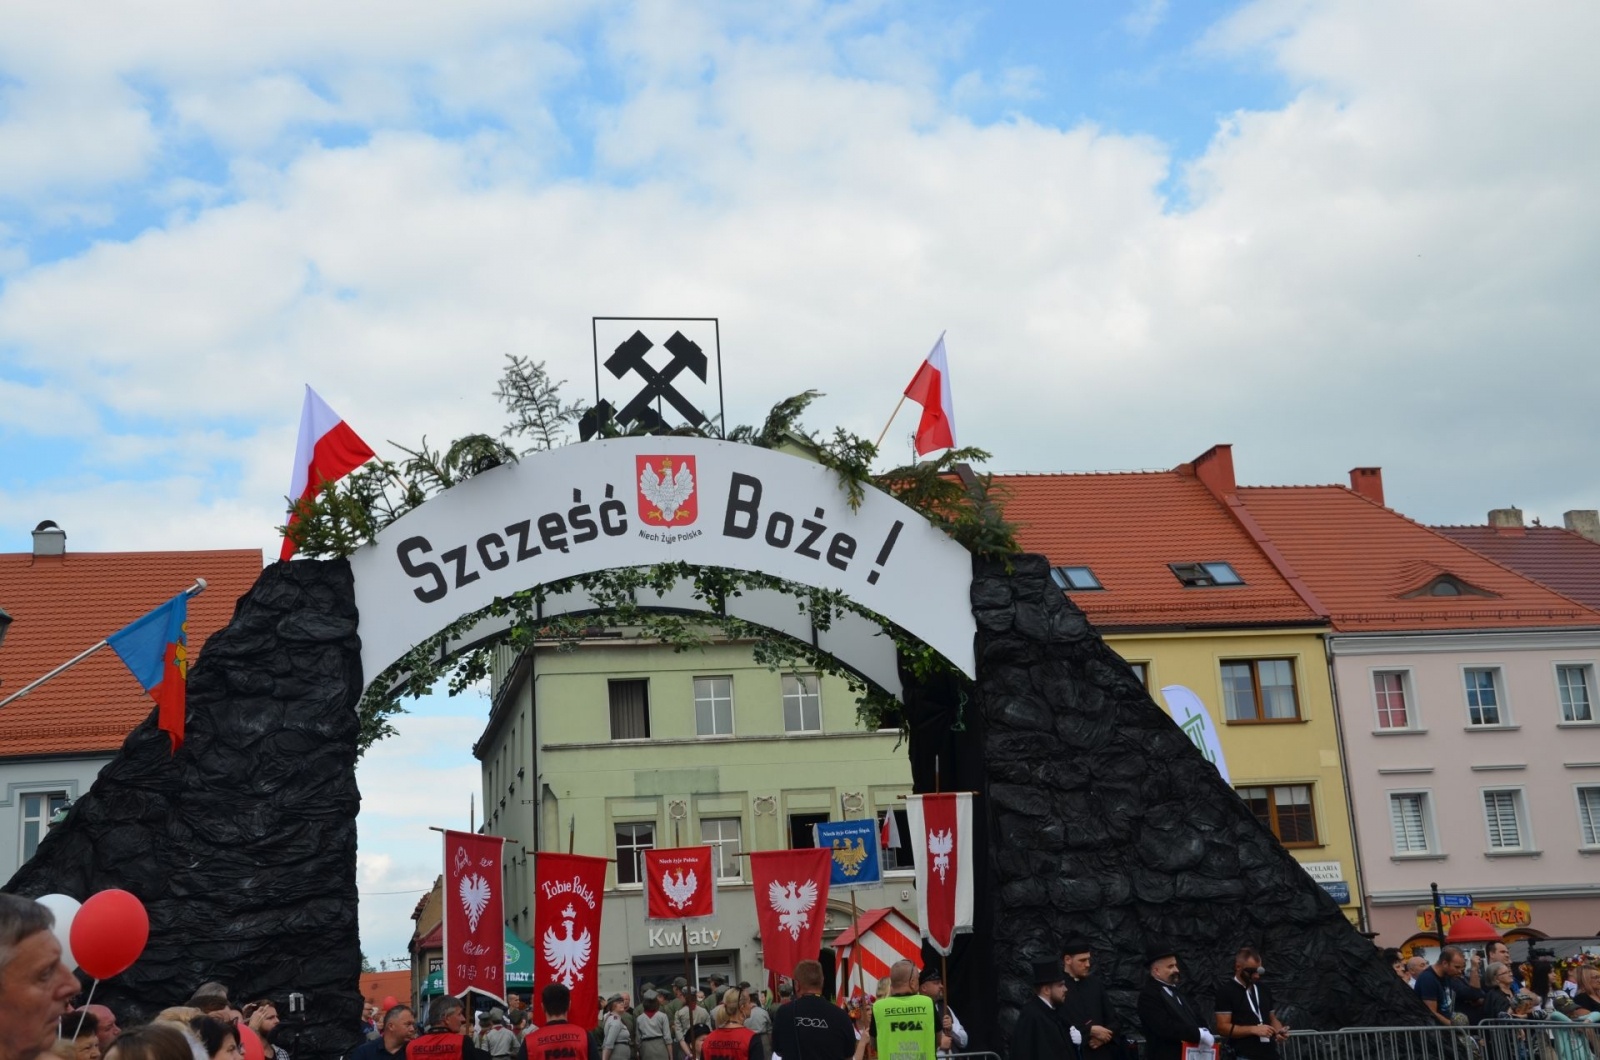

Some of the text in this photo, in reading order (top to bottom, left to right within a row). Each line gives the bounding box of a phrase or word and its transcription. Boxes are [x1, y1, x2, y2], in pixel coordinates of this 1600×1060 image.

[638, 529, 660, 542] Niech
[677, 529, 703, 542] Polska
[397, 483, 628, 604] Szczęść
[541, 880, 572, 900] Tobie
[457, 964, 497, 980] 19 19
[884, 1006, 927, 1015] SECURITY
[537, 1033, 580, 1045] SECURITY
[412, 1044, 456, 1054] SECURITY
